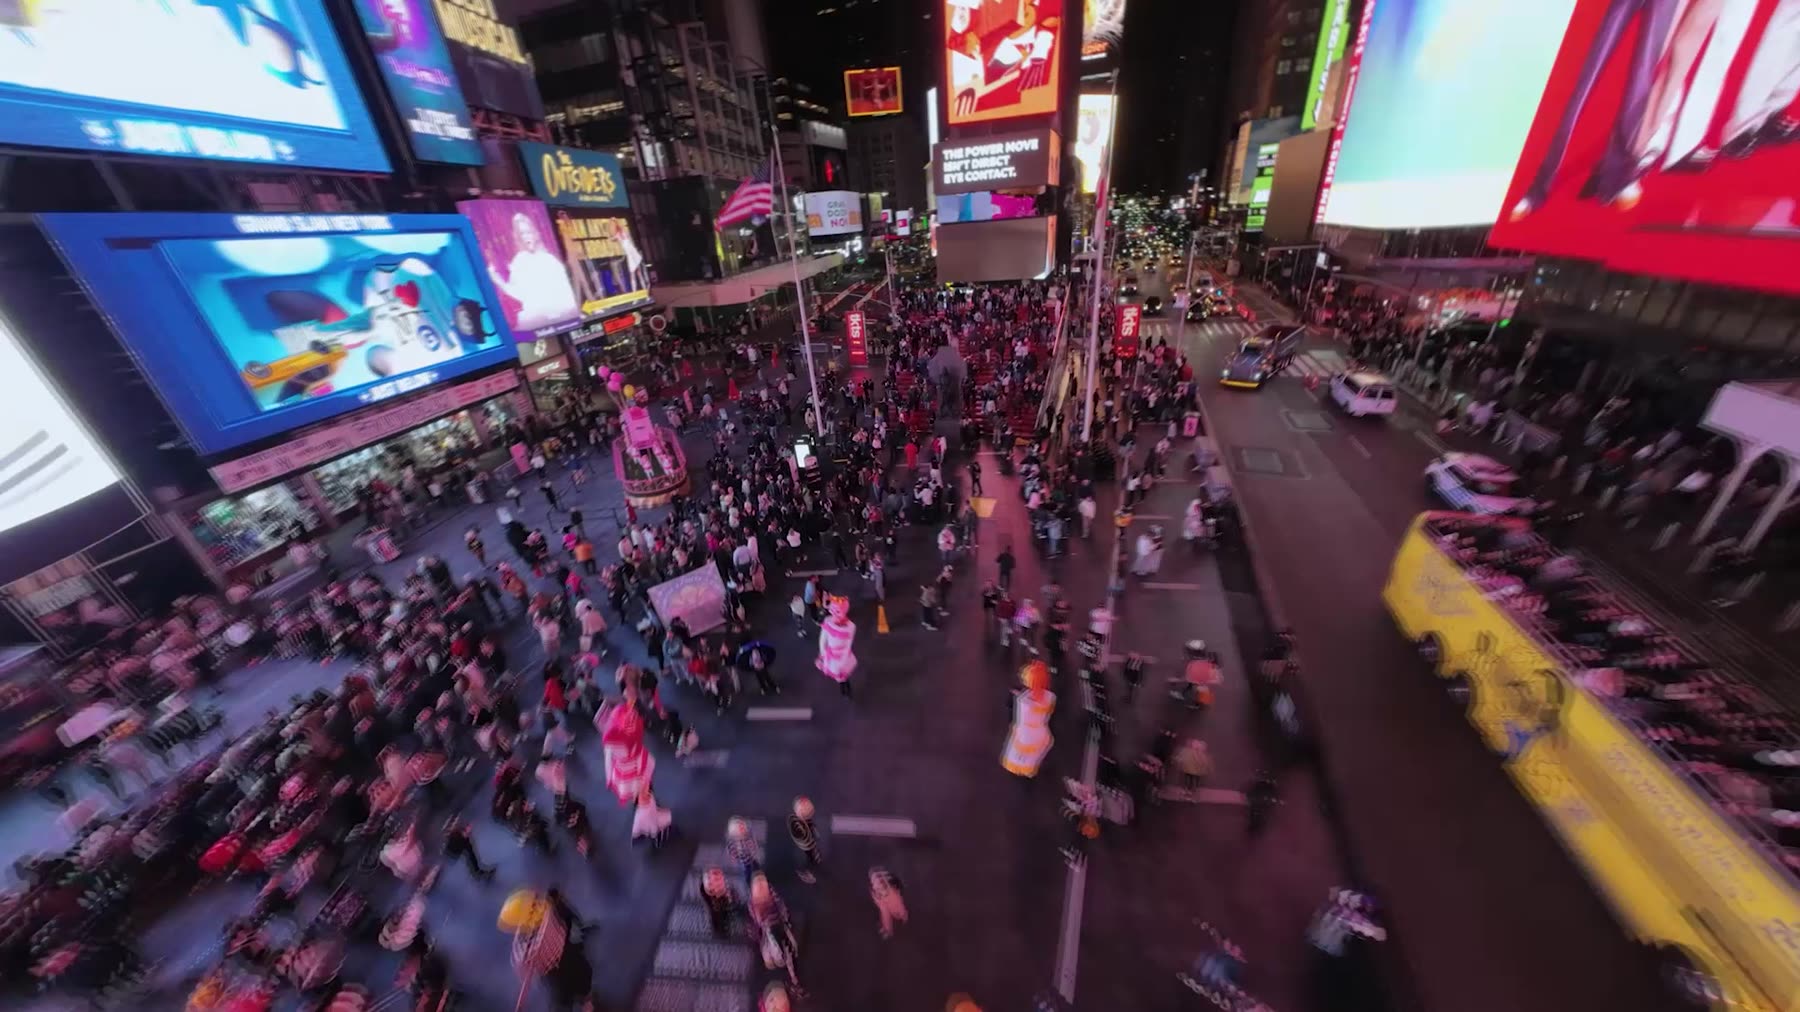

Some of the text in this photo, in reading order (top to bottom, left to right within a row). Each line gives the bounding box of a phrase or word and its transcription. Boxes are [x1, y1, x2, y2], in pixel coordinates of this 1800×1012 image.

[942, 139, 1039, 160] THE POWER MOVE
[943, 154, 1010, 172] ISN'T DIRECT
[943, 166, 1017, 184] EYE CONTACT.
[849, 313, 862, 338] tkts
